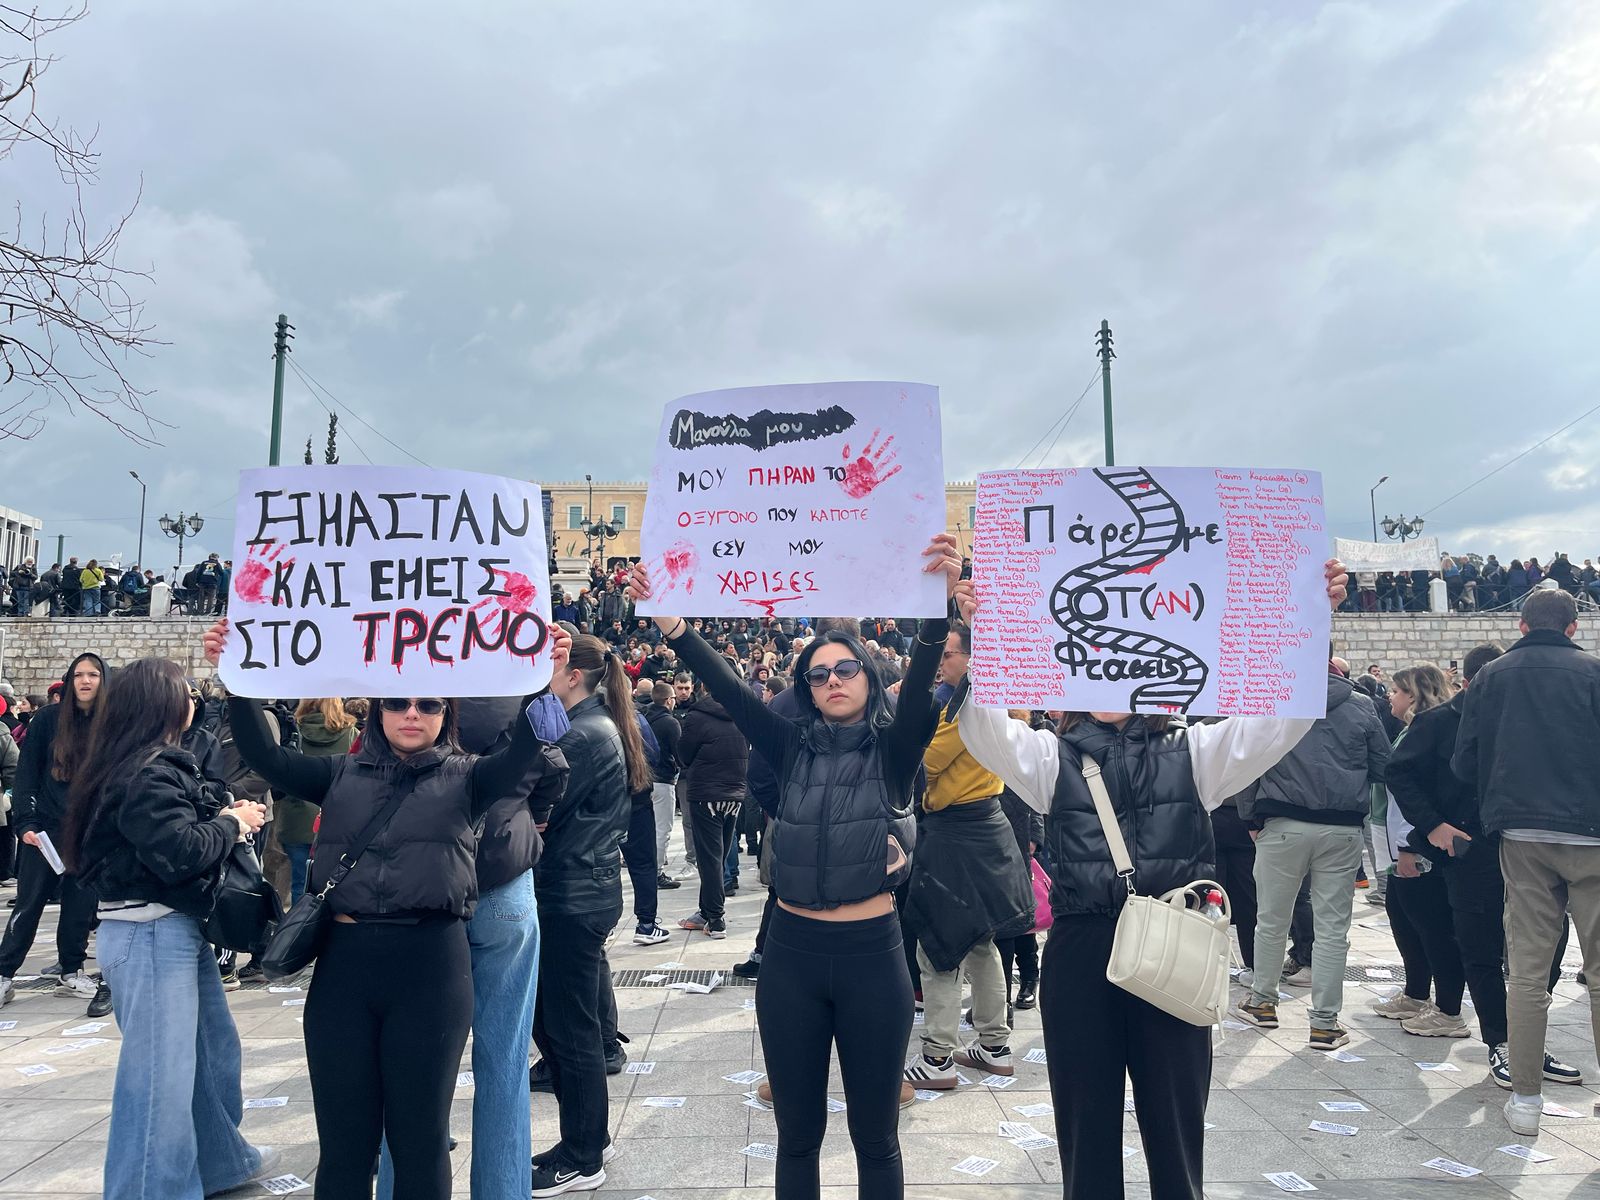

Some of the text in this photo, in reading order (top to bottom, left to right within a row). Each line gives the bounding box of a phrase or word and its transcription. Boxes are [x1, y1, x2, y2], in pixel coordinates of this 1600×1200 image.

[677, 466, 847, 493] ΜΟΥ ΠΗΡΑΝ ΤΟ
[677, 507, 870, 528] ΟΞΥΓΟΝΟ ΠΟΥ ΚΑΠΟΤΕ
[712, 538, 824, 558] ΕΣΥ ΜΟΥ
[272, 556, 512, 608] ΚΑΙ ΕΜΕΙΣ
[716, 570, 820, 595] ΧΑΡΙΣΕΣ
[235, 608, 549, 670] ΣΤΟ ΤΡΕΝΟ
